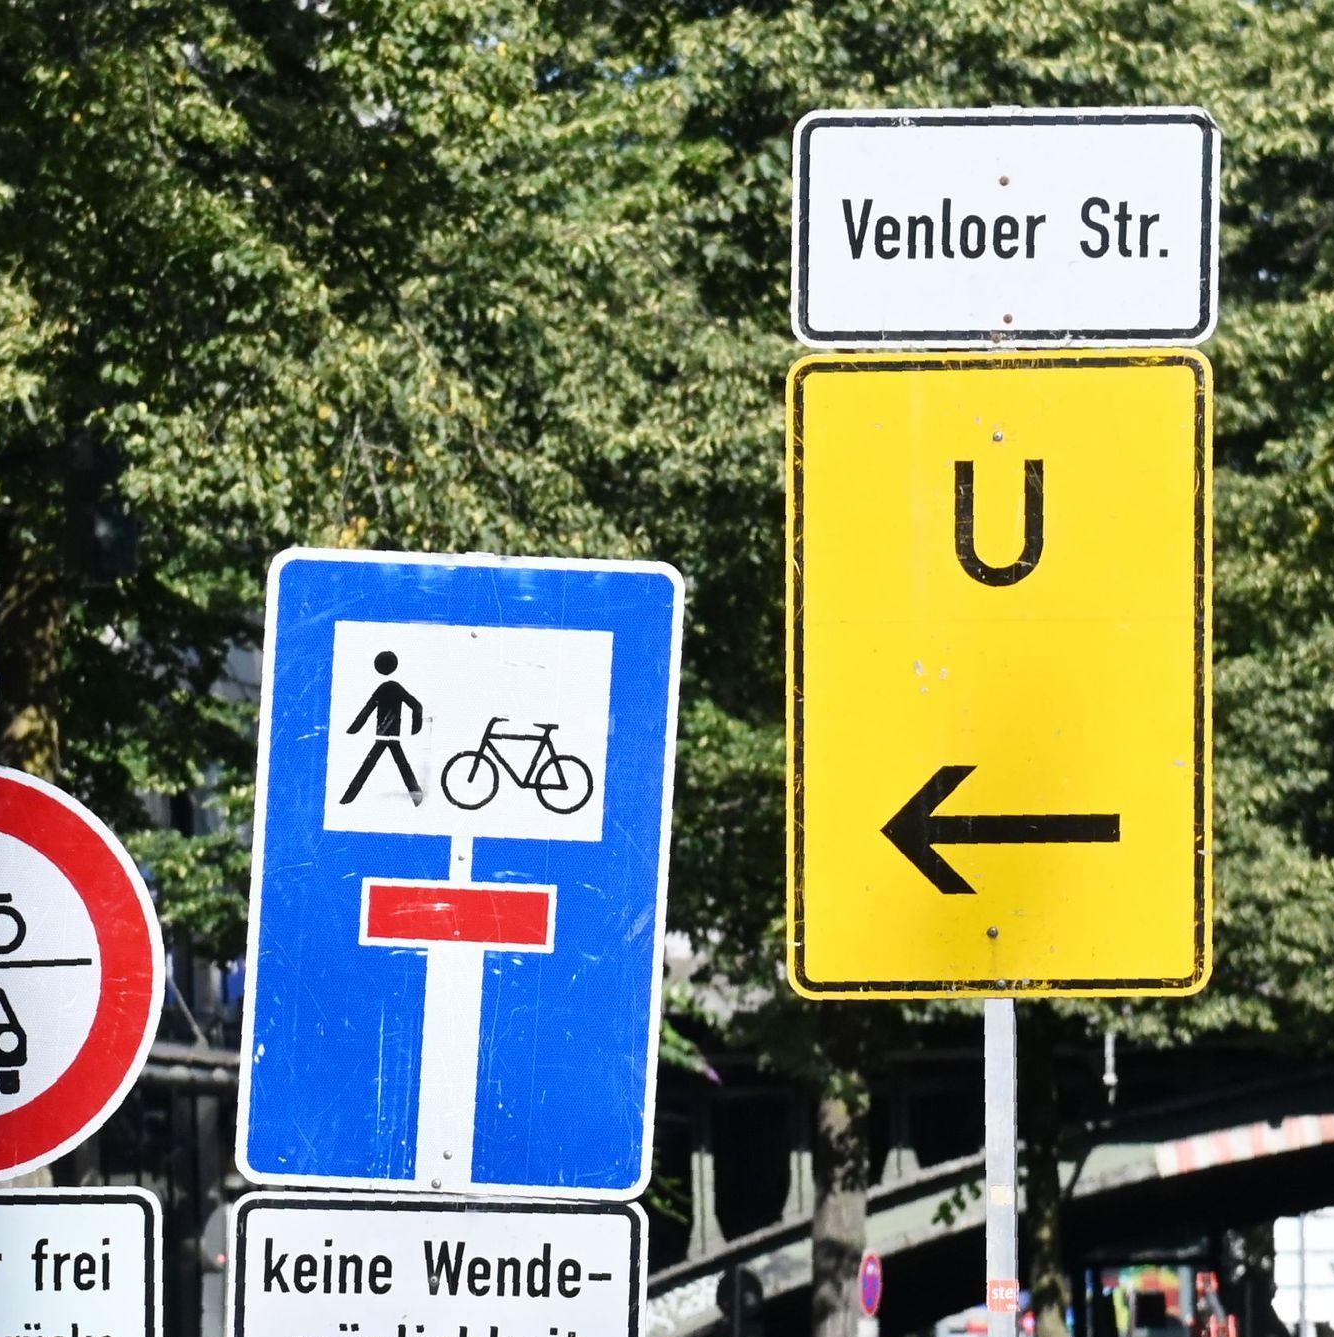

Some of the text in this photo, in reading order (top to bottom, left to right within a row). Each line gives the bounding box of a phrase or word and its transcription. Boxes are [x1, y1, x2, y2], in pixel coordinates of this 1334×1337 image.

[842, 196, 1169, 260] Venloer Str.
[954, 458, 1044, 587] U
[30, 1238, 111, 1291] frei
[263, 1238, 613, 1299] keine Wende-
[991, 1287, 1018, 1300] ste
